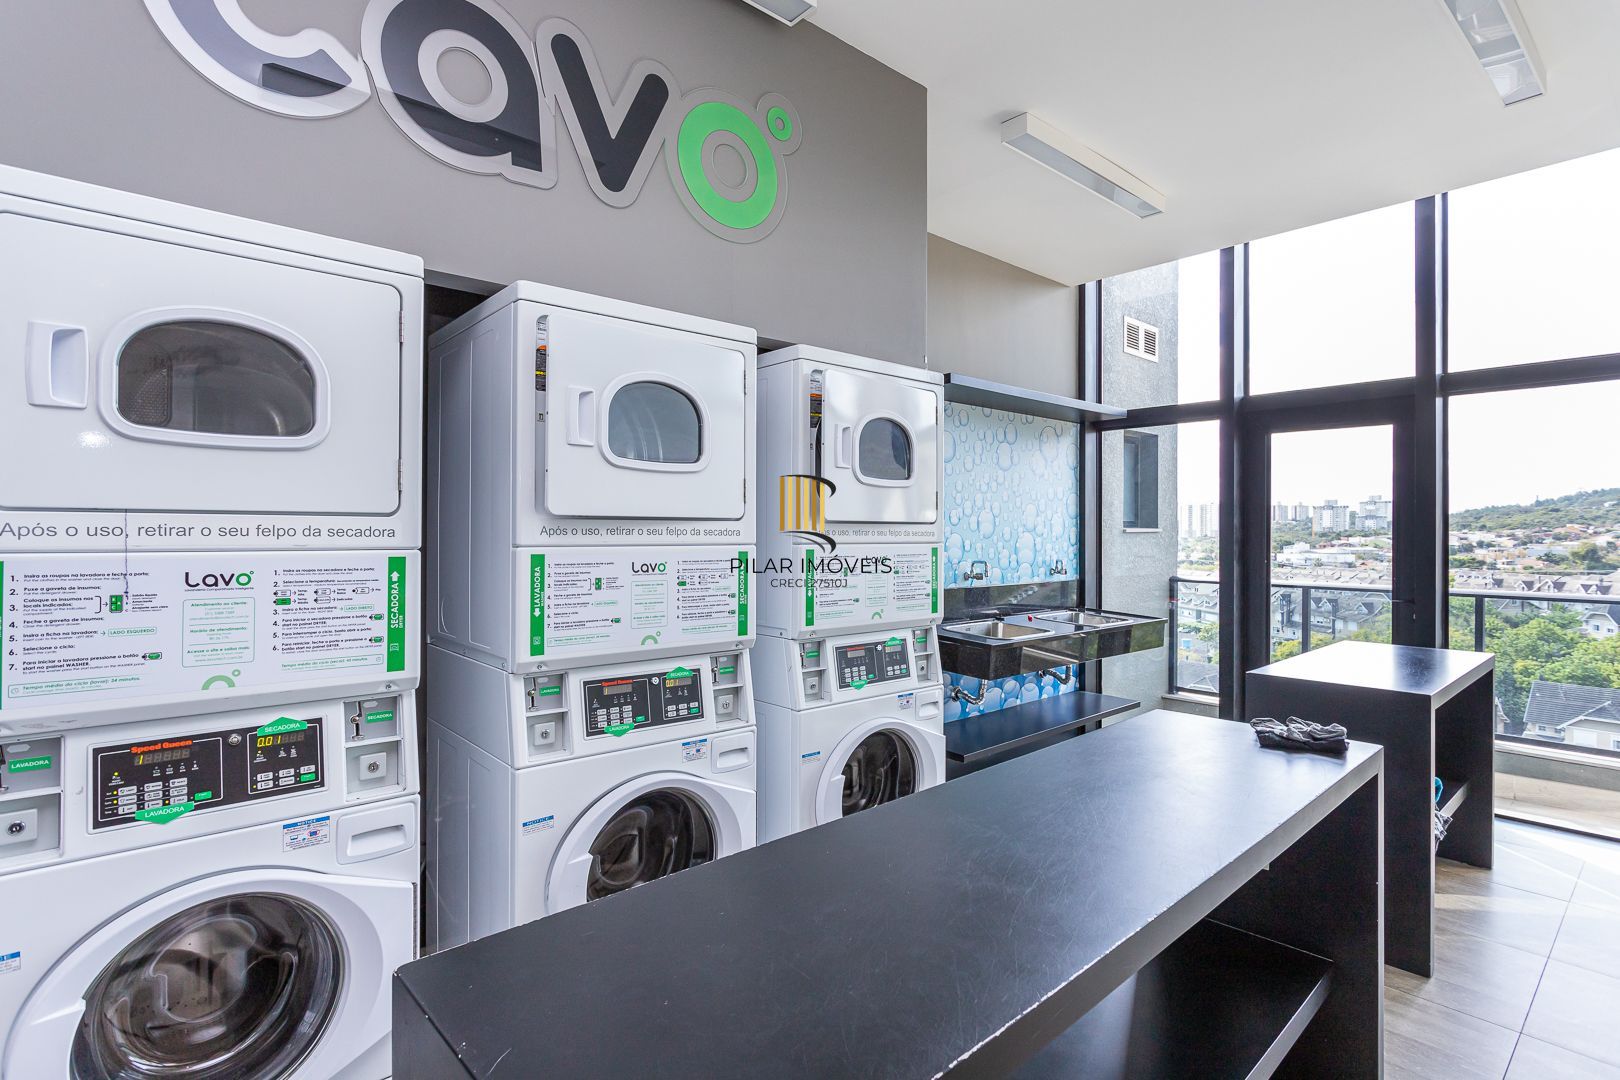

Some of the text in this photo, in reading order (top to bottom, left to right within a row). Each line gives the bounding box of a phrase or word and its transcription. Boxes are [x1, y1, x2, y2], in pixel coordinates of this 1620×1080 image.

[0, 522, 57, 540] Após
[65, 526, 78, 537] o
[138, 524, 195, 537] retirar
[201, 527, 211, 537] o
[218, 527, 249, 537] seu
[256, 524, 296, 540] felpo
[302, 525, 321, 537] da
[327, 526, 395, 537] secadora
[540, 525, 740, 538] Após o uso, retirar o seu felpo da secadora
[889, 529, 902, 537] felpo
[391, 583, 399, 629] SECADORA
[265, 723, 300, 732] SECADORA
[131, 740, 192, 753] Speed Queen
[11, 760, 49, 769] LAVADORA
[144, 807, 184, 818] LAVADORA
